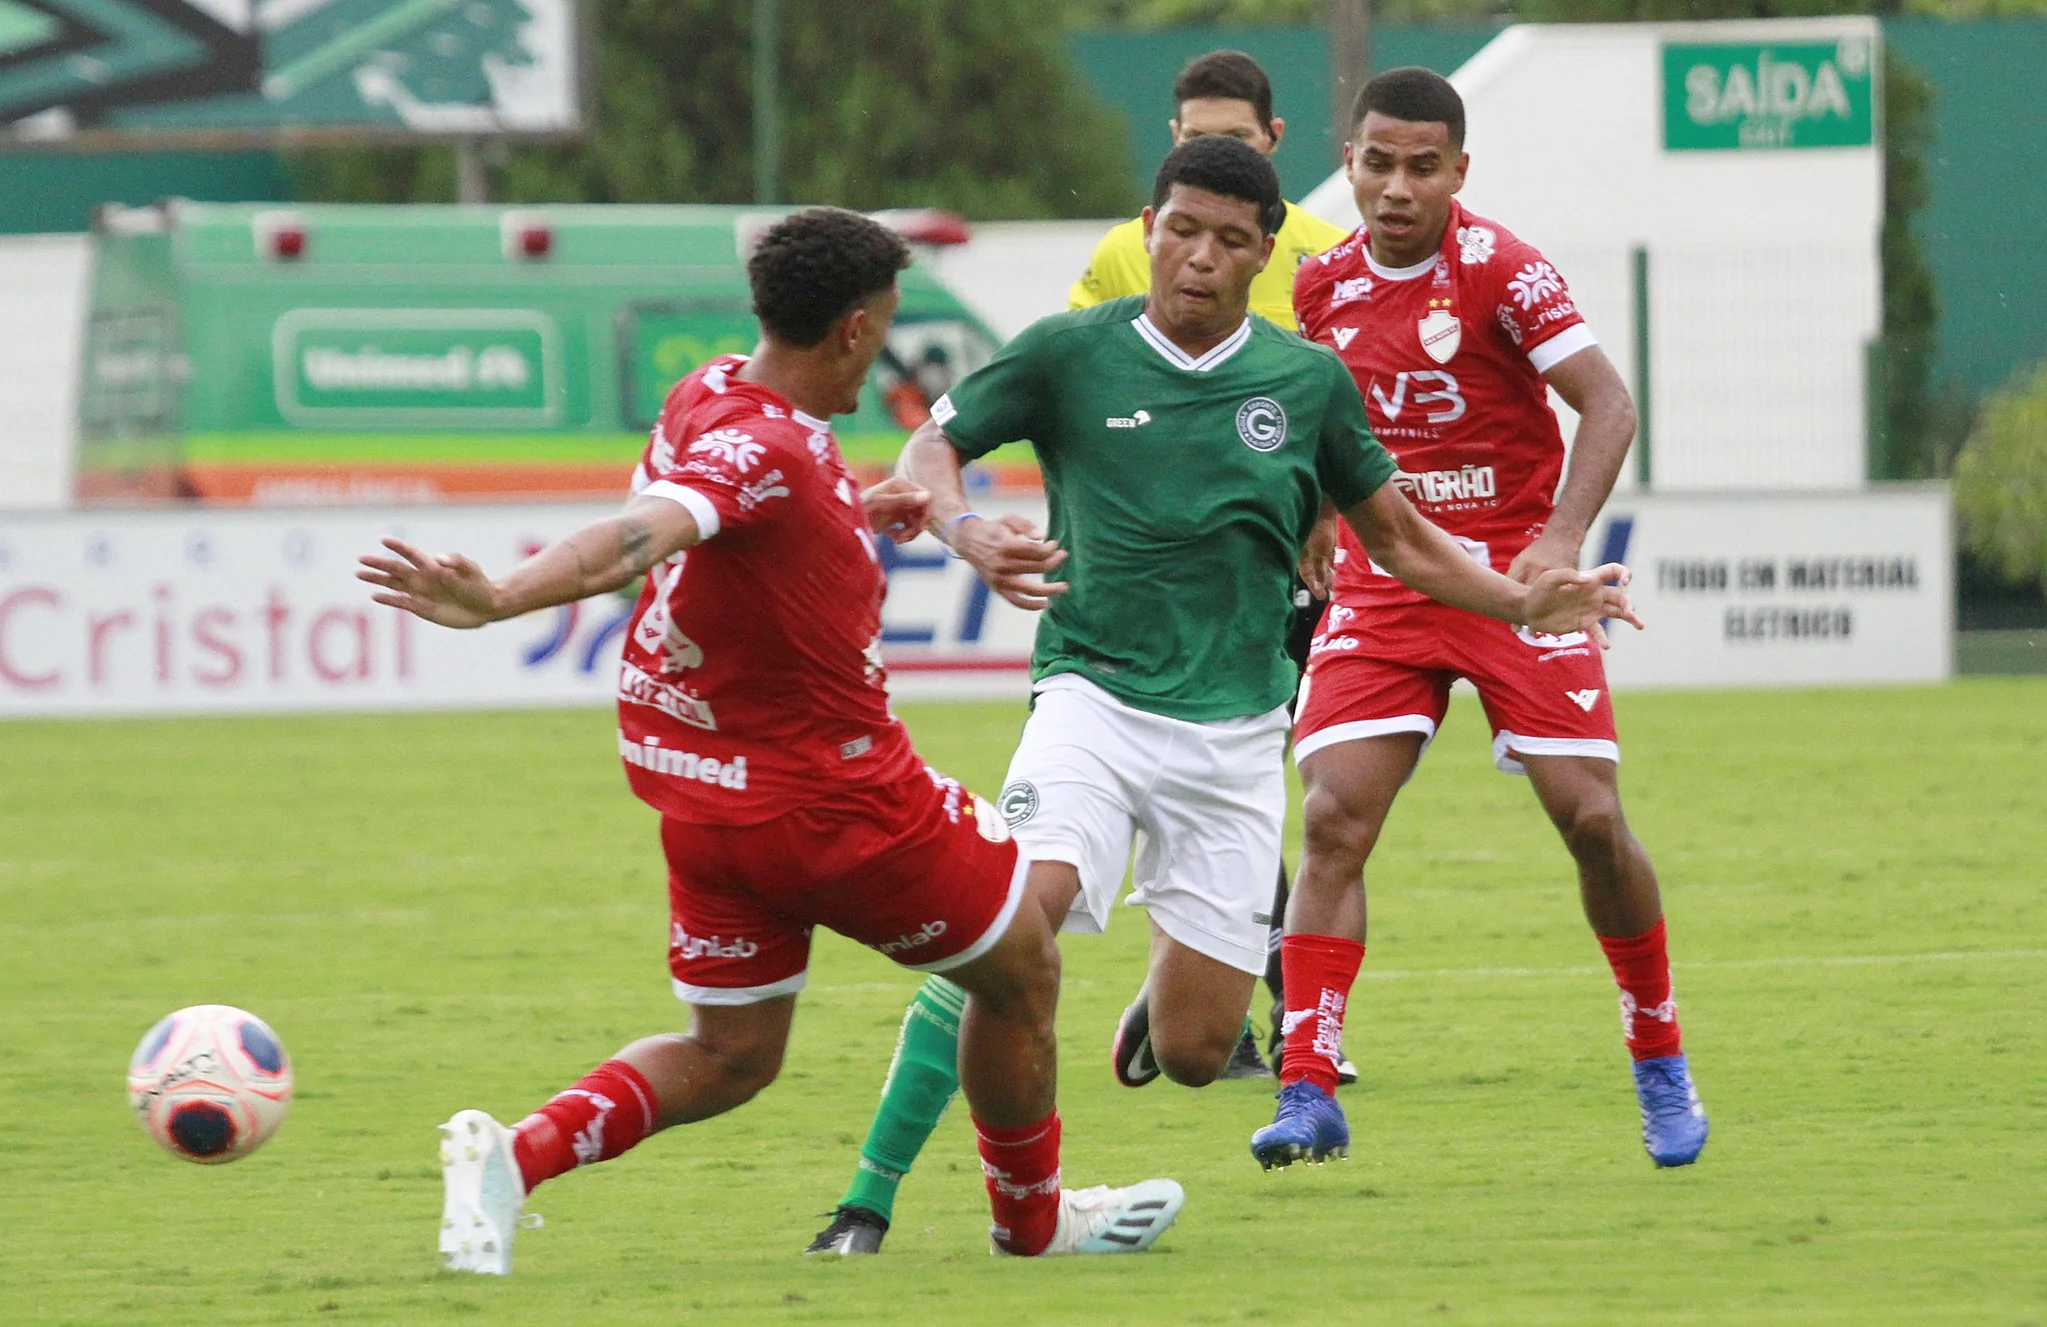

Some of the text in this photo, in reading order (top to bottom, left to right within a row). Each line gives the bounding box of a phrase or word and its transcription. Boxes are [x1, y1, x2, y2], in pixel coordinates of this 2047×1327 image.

[1684, 50, 1852, 126] SAÍDA
[1786, 553, 1919, 592] MATERIAL
[0, 578, 416, 692] Cristal
